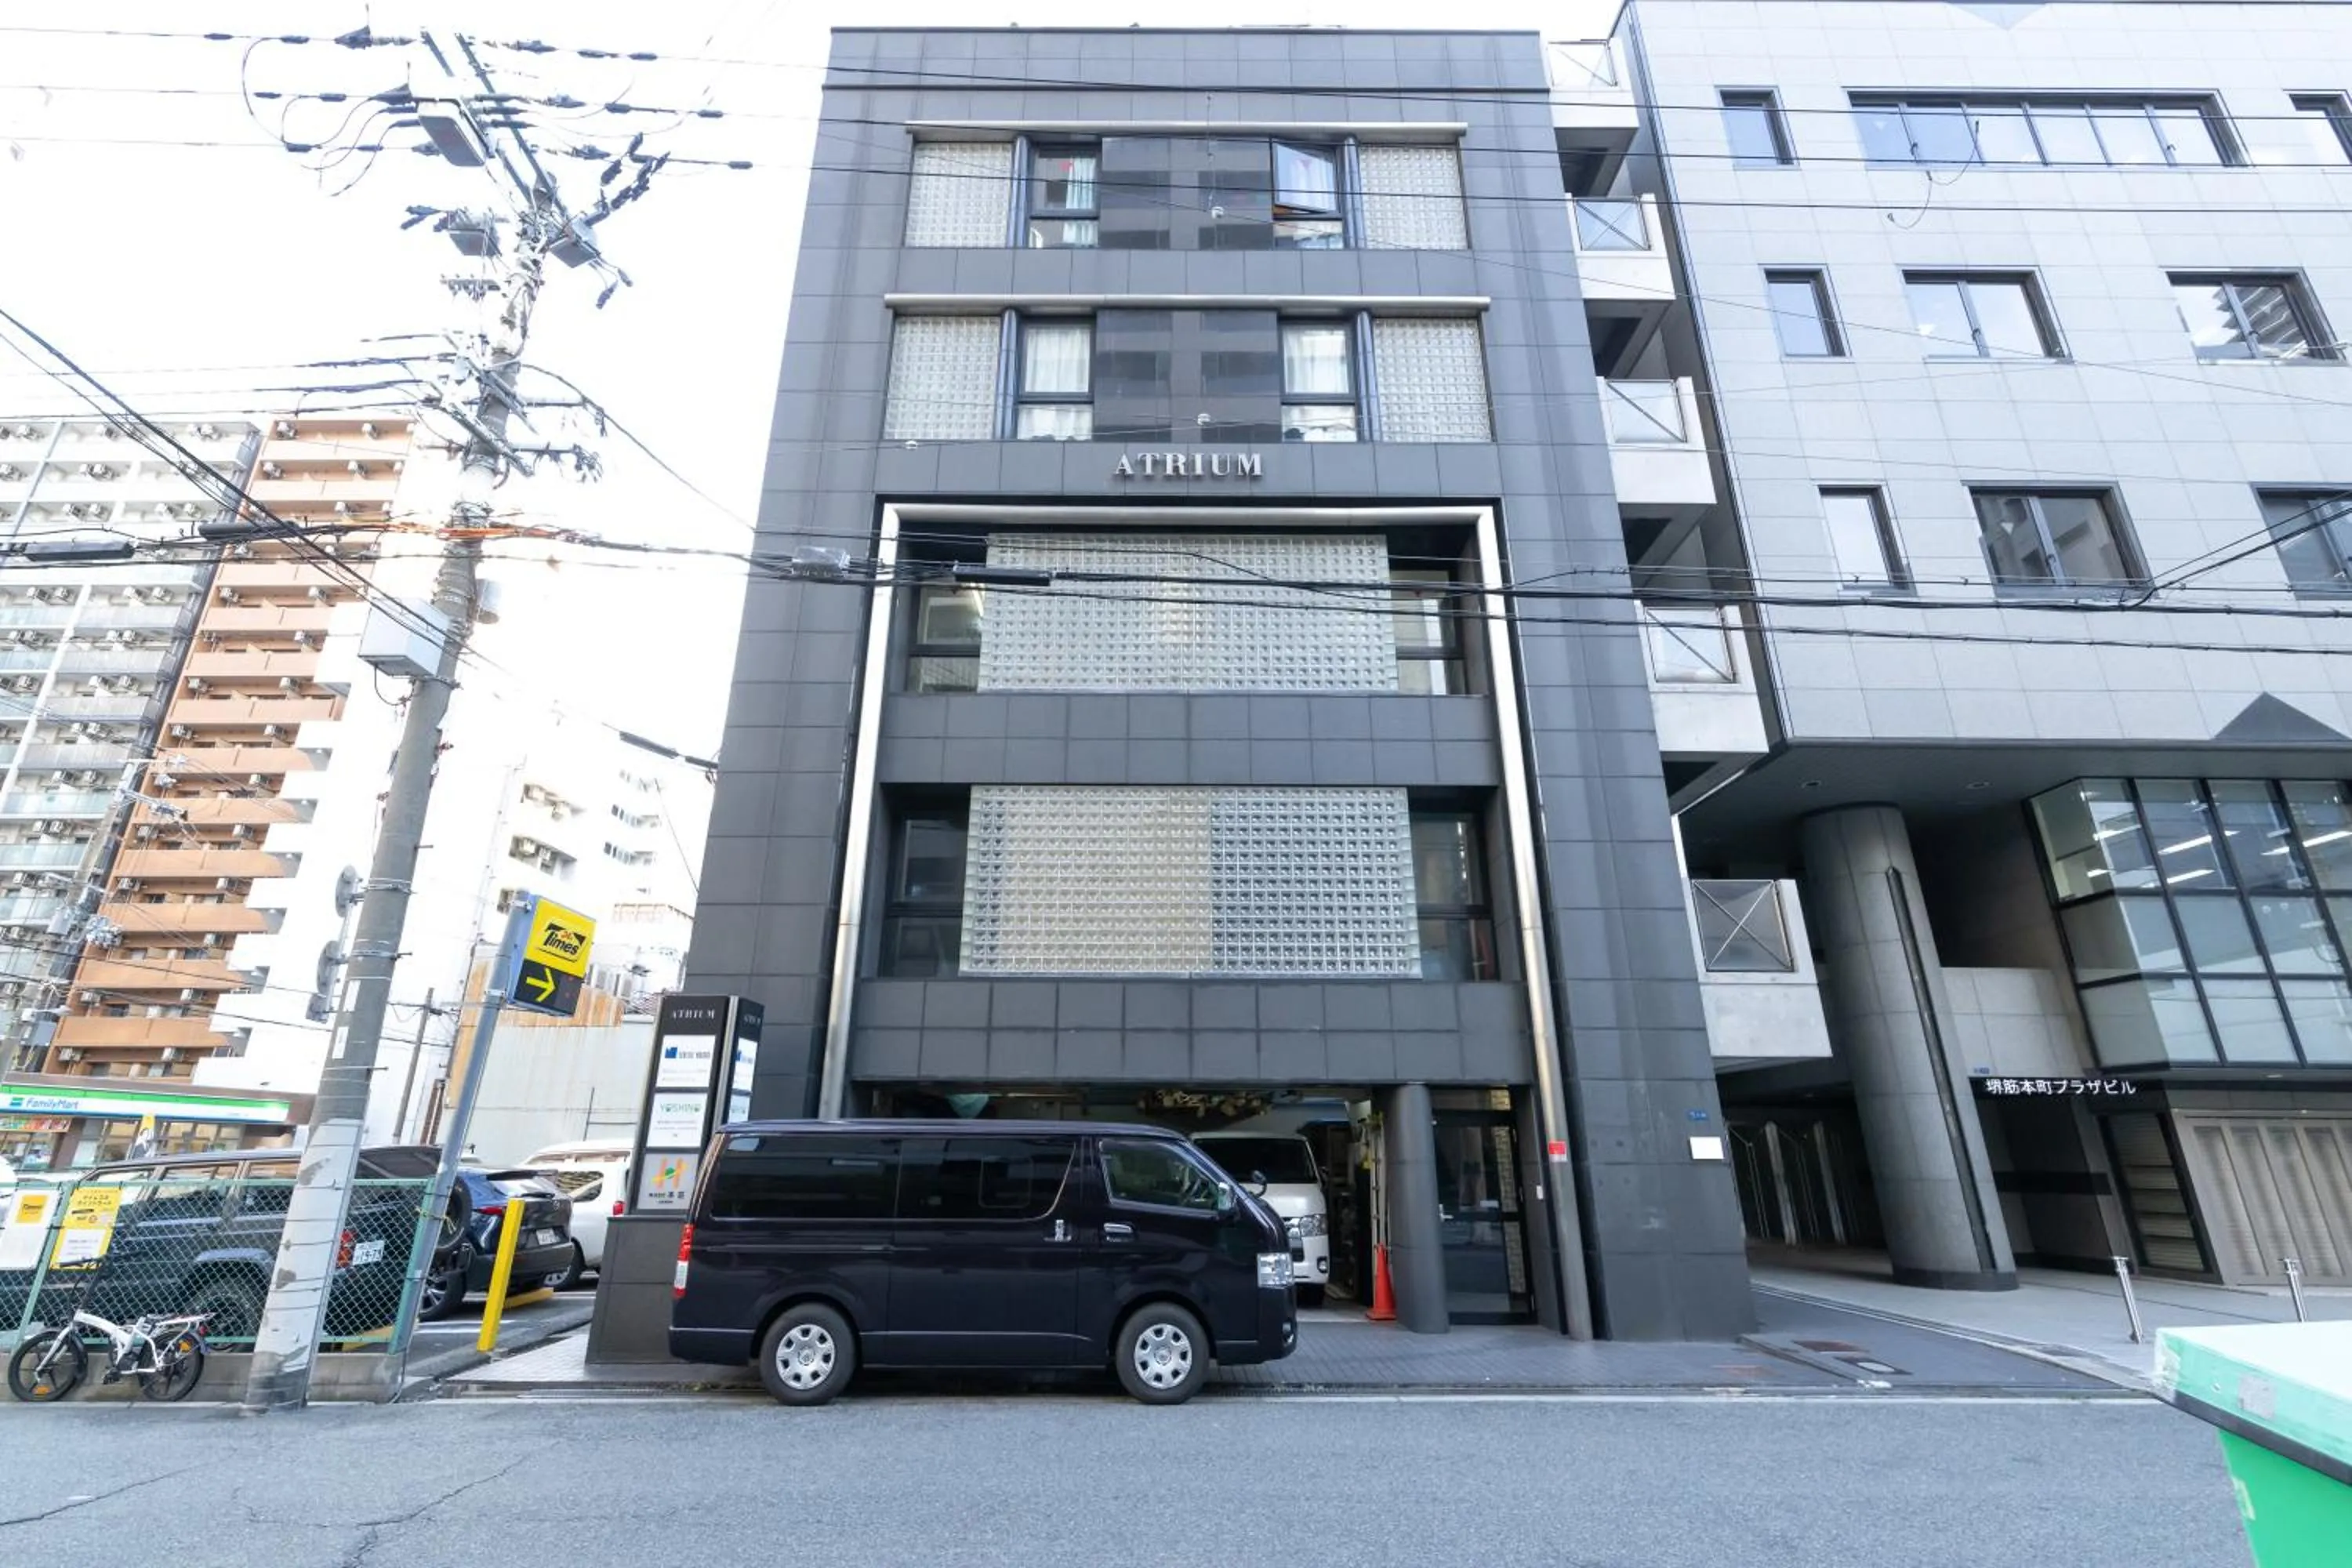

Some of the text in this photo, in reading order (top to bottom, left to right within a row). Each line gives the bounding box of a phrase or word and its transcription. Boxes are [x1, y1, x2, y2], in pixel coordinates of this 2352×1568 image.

[1114, 452, 1263, 476] ATRIUM
[543, 923, 586, 956] Times
[1985, 1079, 2136, 1095] 堺筋本町プラザビル
[26, 1097, 79, 1110] FamilyMart
